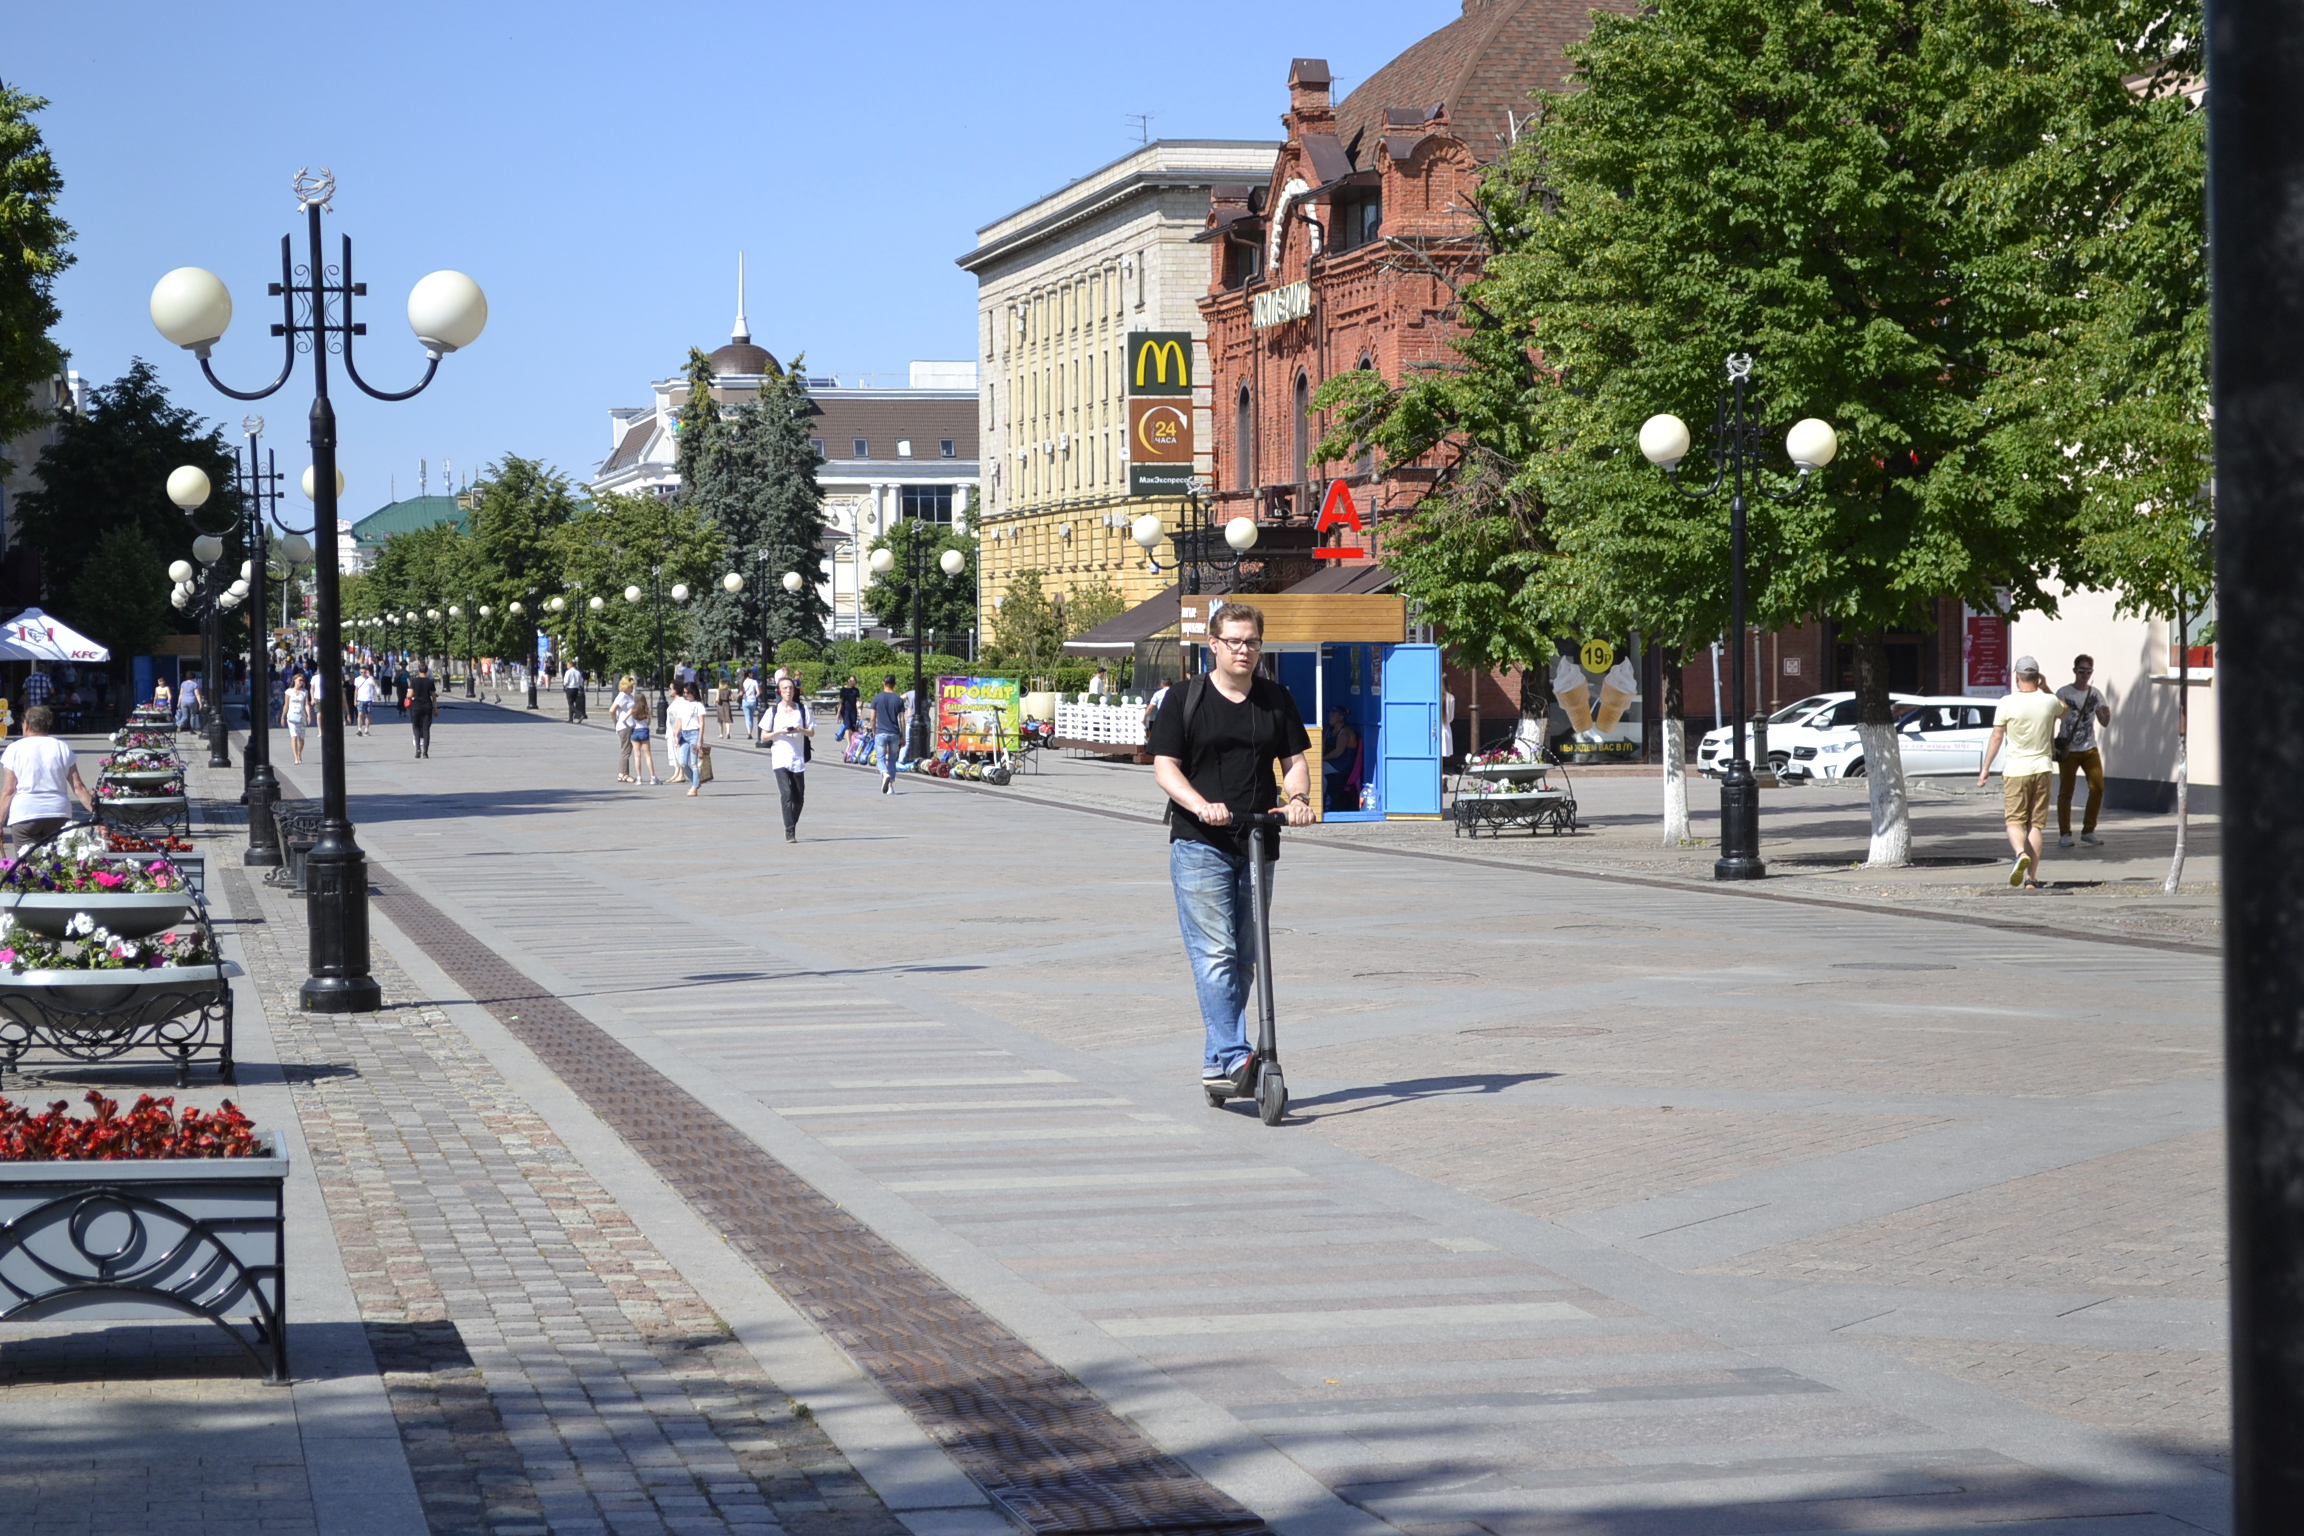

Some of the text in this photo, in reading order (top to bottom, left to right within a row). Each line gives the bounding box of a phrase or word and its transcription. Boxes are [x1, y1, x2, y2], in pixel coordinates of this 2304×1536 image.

[1252, 279, 1311, 331] ИМПЕРИЯ
[1155, 421, 1177, 437] 24
[71, 650, 98, 659] KFC
[943, 685, 1015, 699] ПРОКАТ
[1560, 744, 1573, 752] МЫ
[1598, 743, 1615, 751] ВАС
[1616, 743, 1622, 751] В
